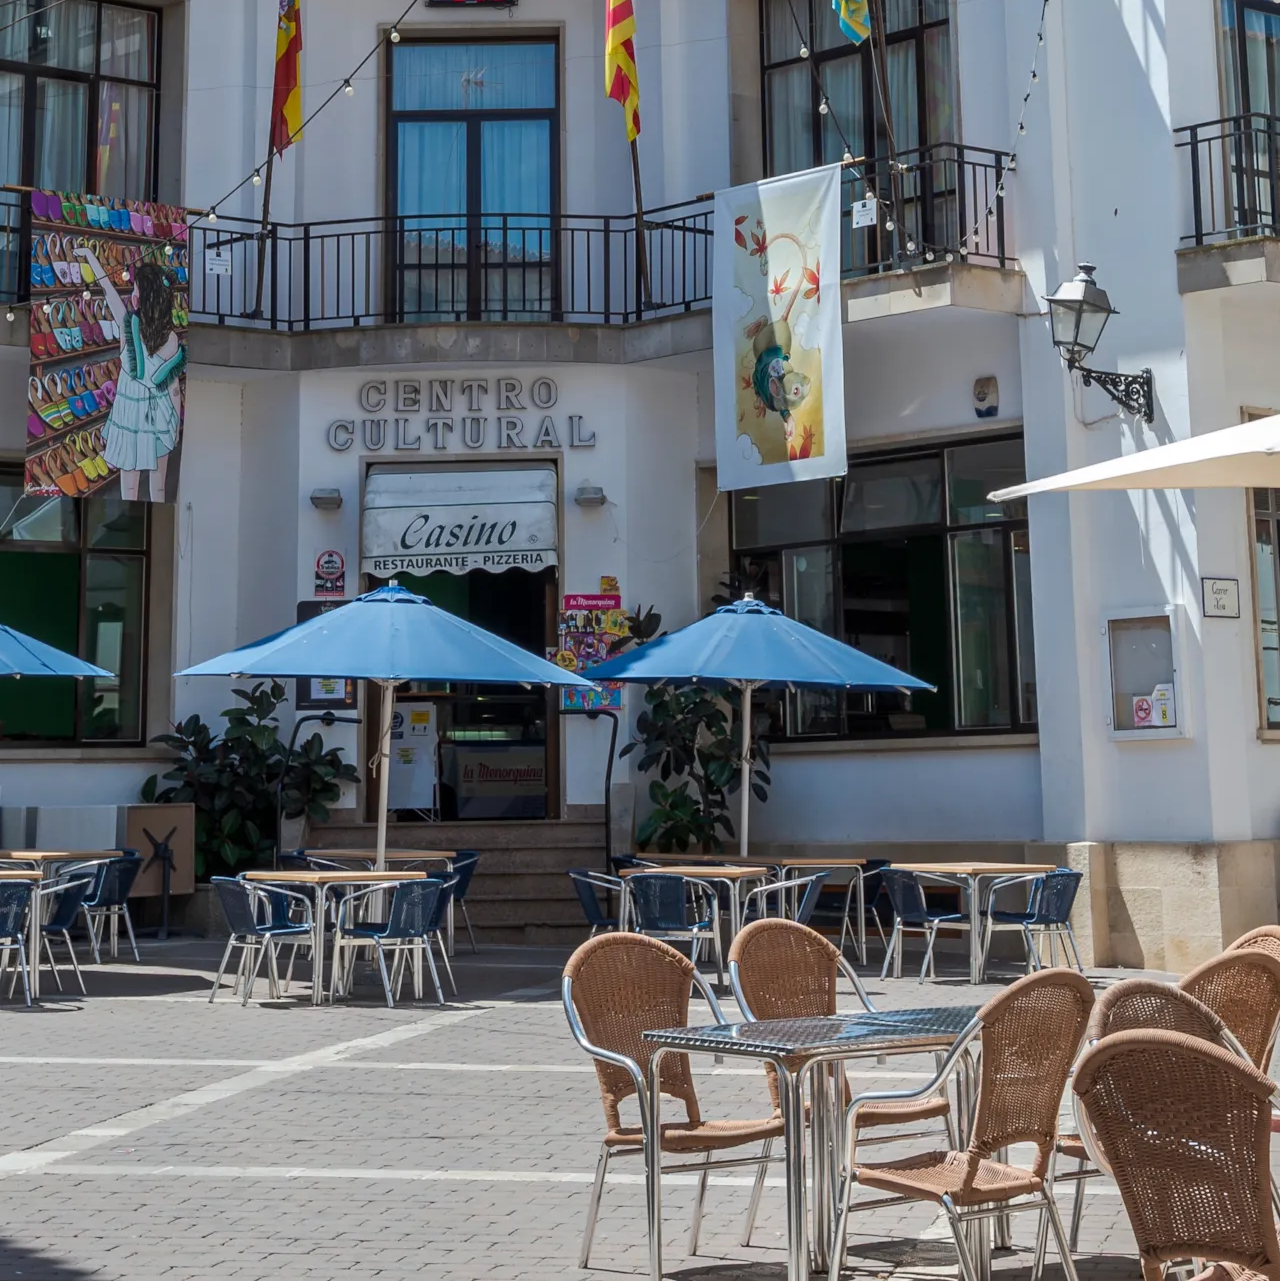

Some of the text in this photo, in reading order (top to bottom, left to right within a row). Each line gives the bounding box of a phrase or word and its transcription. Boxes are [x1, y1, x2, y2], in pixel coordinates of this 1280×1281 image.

[360, 377, 558, 413] CENTRO
[327, 415, 596, 452] CULTURAL
[400, 514, 517, 550] Casino
[373, 556, 469, 571] RESTAURANTE
[483, 553, 544, 565] PIZZERIA
[477, 762, 543, 785] Menorquina
